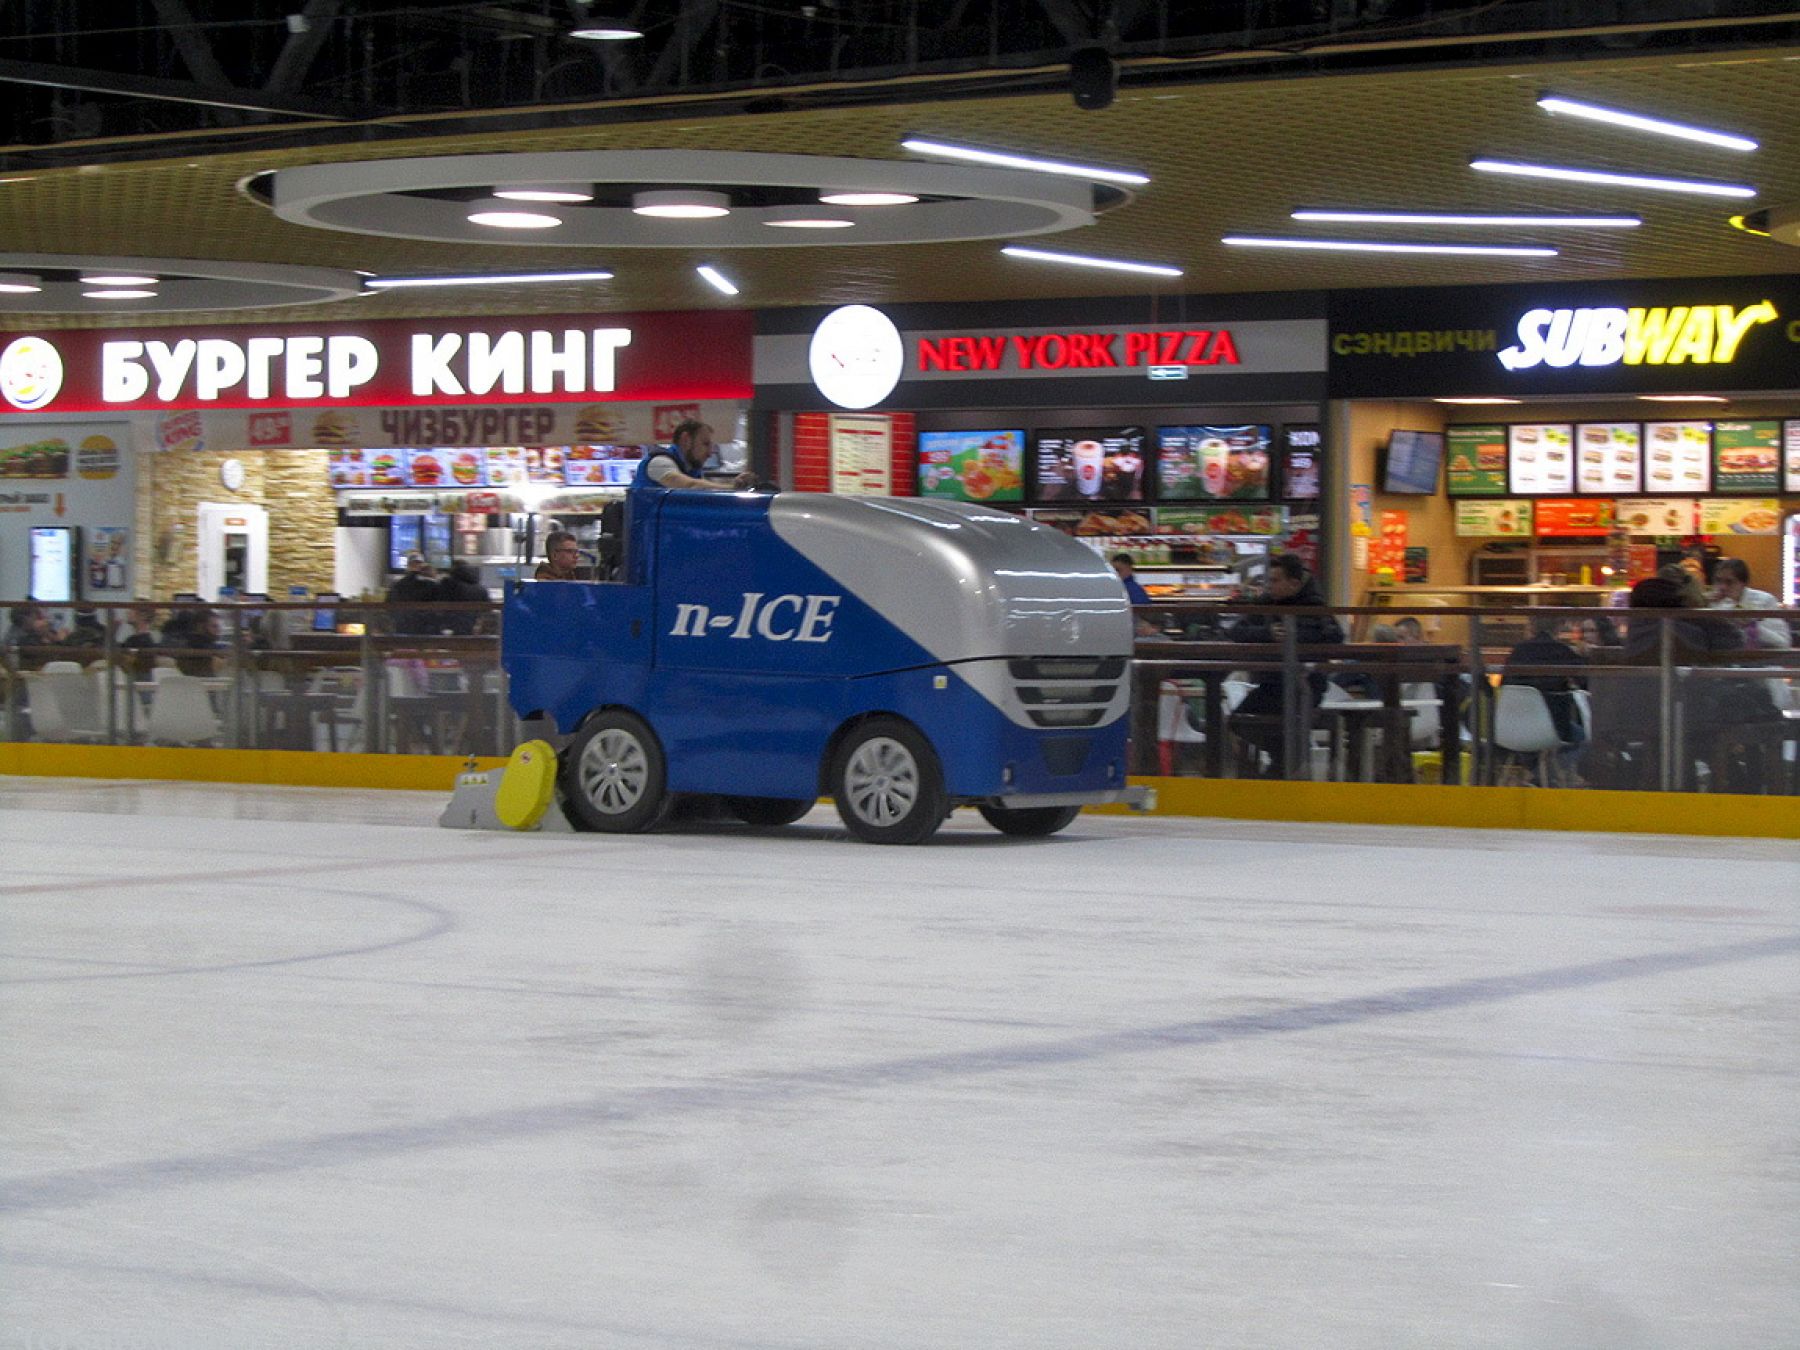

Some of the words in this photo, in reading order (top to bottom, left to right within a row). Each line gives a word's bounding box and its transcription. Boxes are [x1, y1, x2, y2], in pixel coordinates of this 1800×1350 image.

[918, 337, 1006, 373] NEW
[1013, 333, 1117, 371] YORK
[1126, 329, 1240, 367] PIZZA
[1333, 329, 1497, 358] СЭНДВИЧИ
[1499, 300, 1778, 371] SUBWAY
[102, 335, 378, 403] БУРГЕР
[411, 328, 632, 396] КИНГ
[381, 408, 555, 446] ЧИЗБУРГЕР
[669, 592, 842, 643] n-ICE
